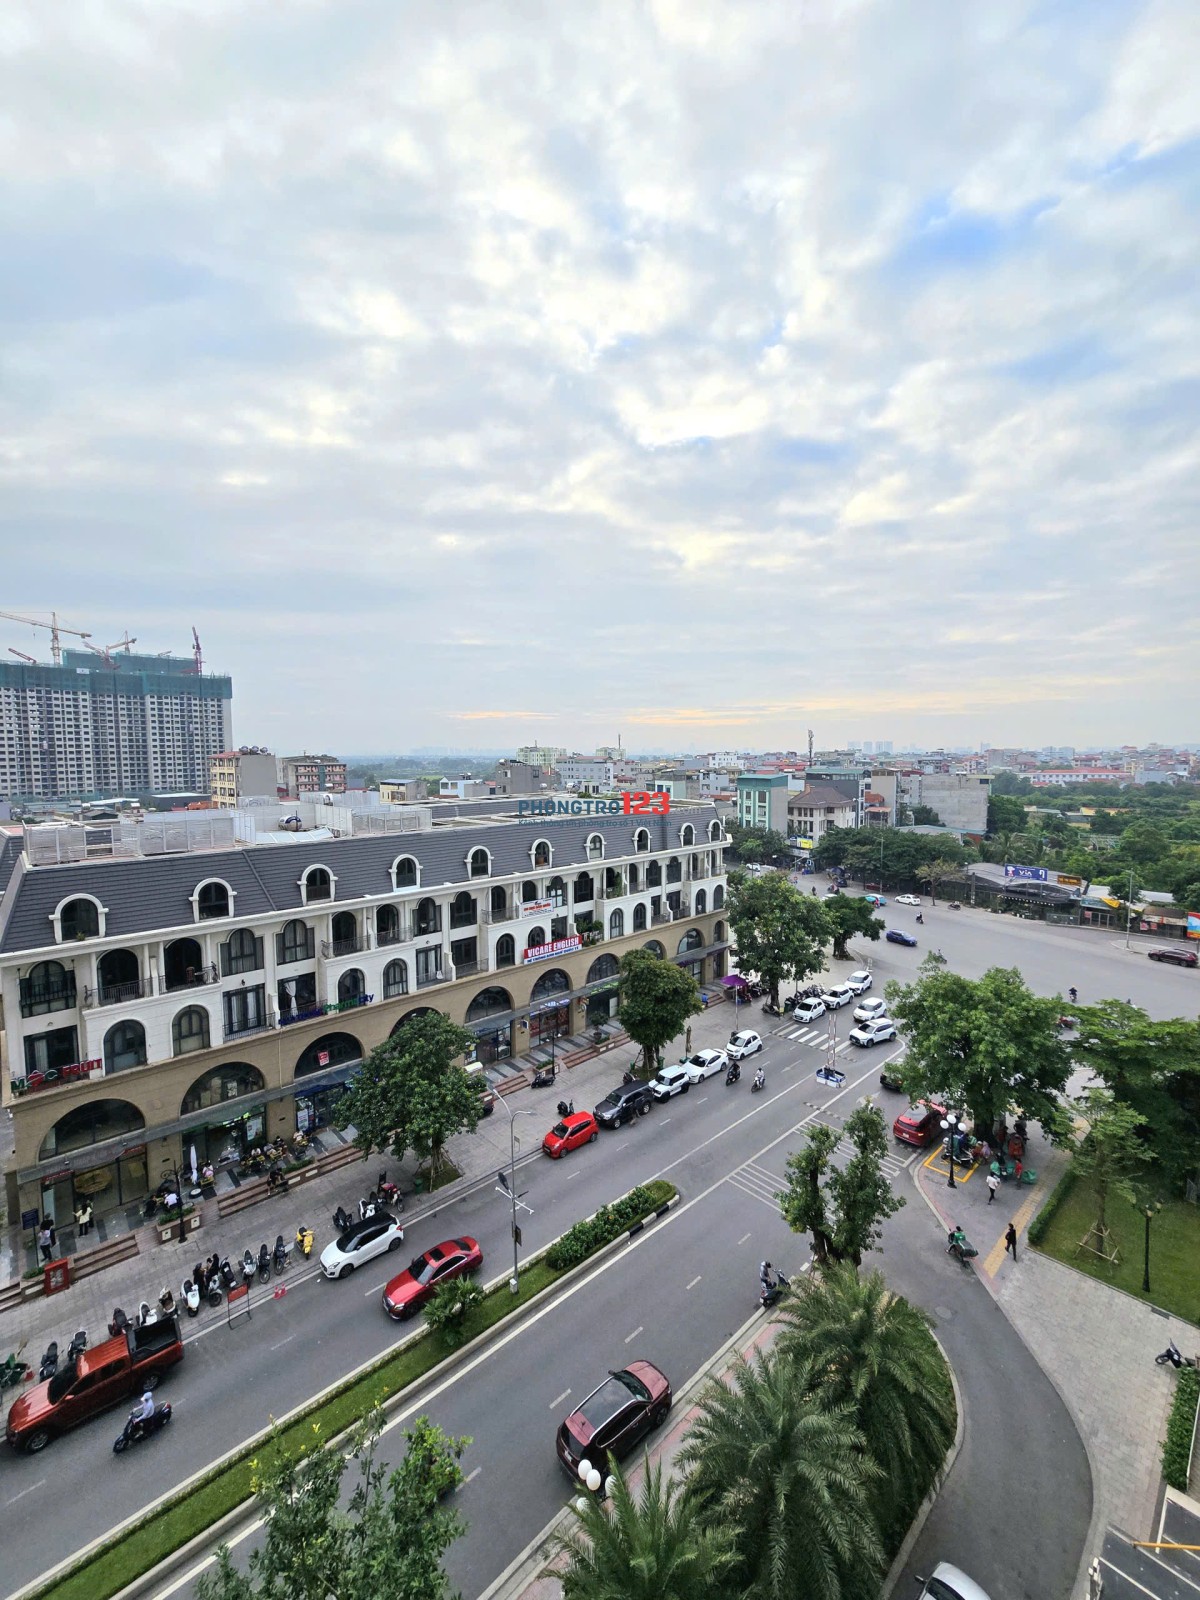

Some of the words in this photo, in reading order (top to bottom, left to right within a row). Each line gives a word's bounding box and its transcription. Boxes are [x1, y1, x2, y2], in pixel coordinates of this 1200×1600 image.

[527, 944, 553, 957] VICARE
[553, 937, 579, 952] ENGLISH
[62, 1058, 103, 1079] FRUIT
